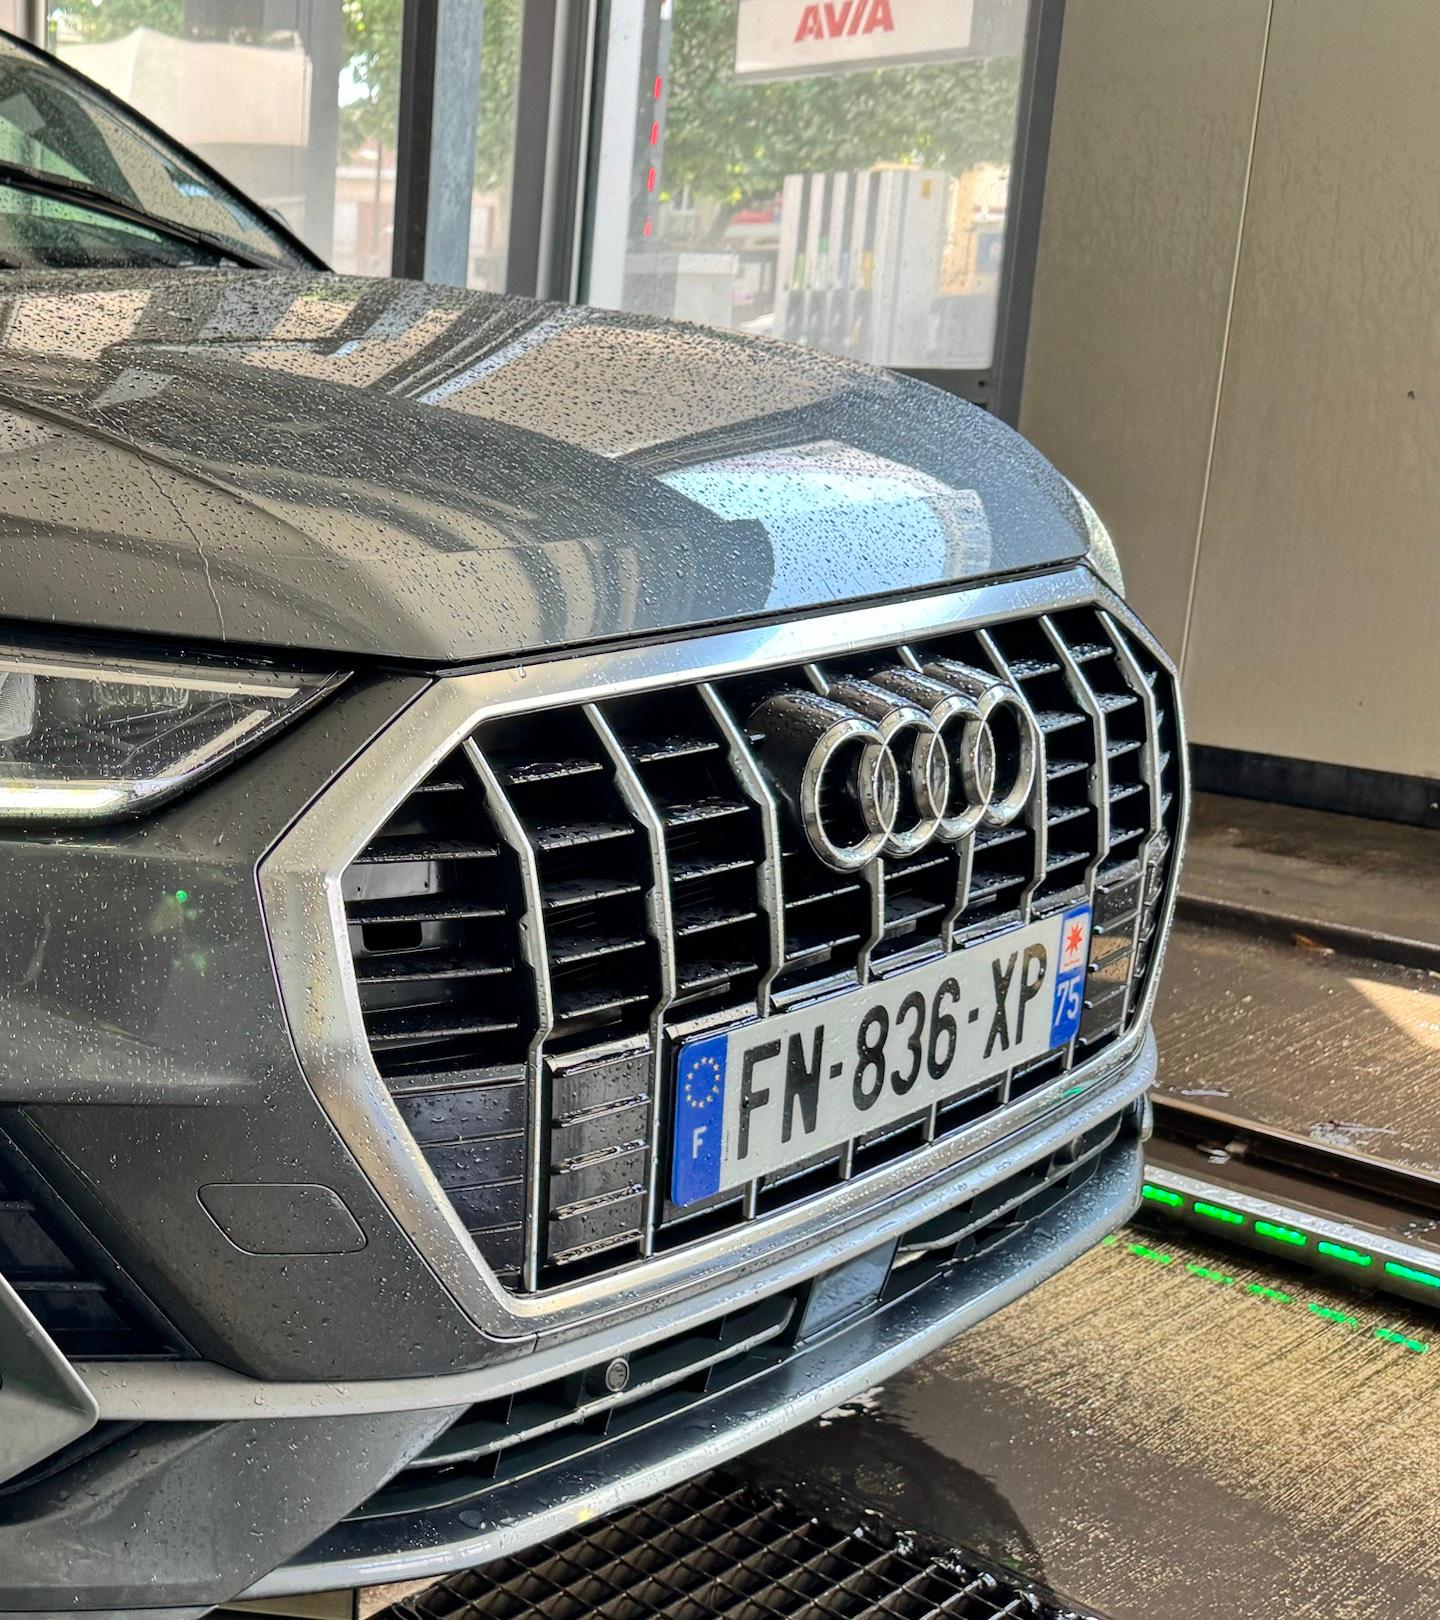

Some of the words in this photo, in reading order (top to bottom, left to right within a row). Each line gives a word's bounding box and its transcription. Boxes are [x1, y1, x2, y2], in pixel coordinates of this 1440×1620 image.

[792, 0, 895, 43] AVIA
[1055, 975, 1081, 1027] 75
[736, 942, 1048, 1160] FN-836-XP
[691, 1125, 707, 1160] F
